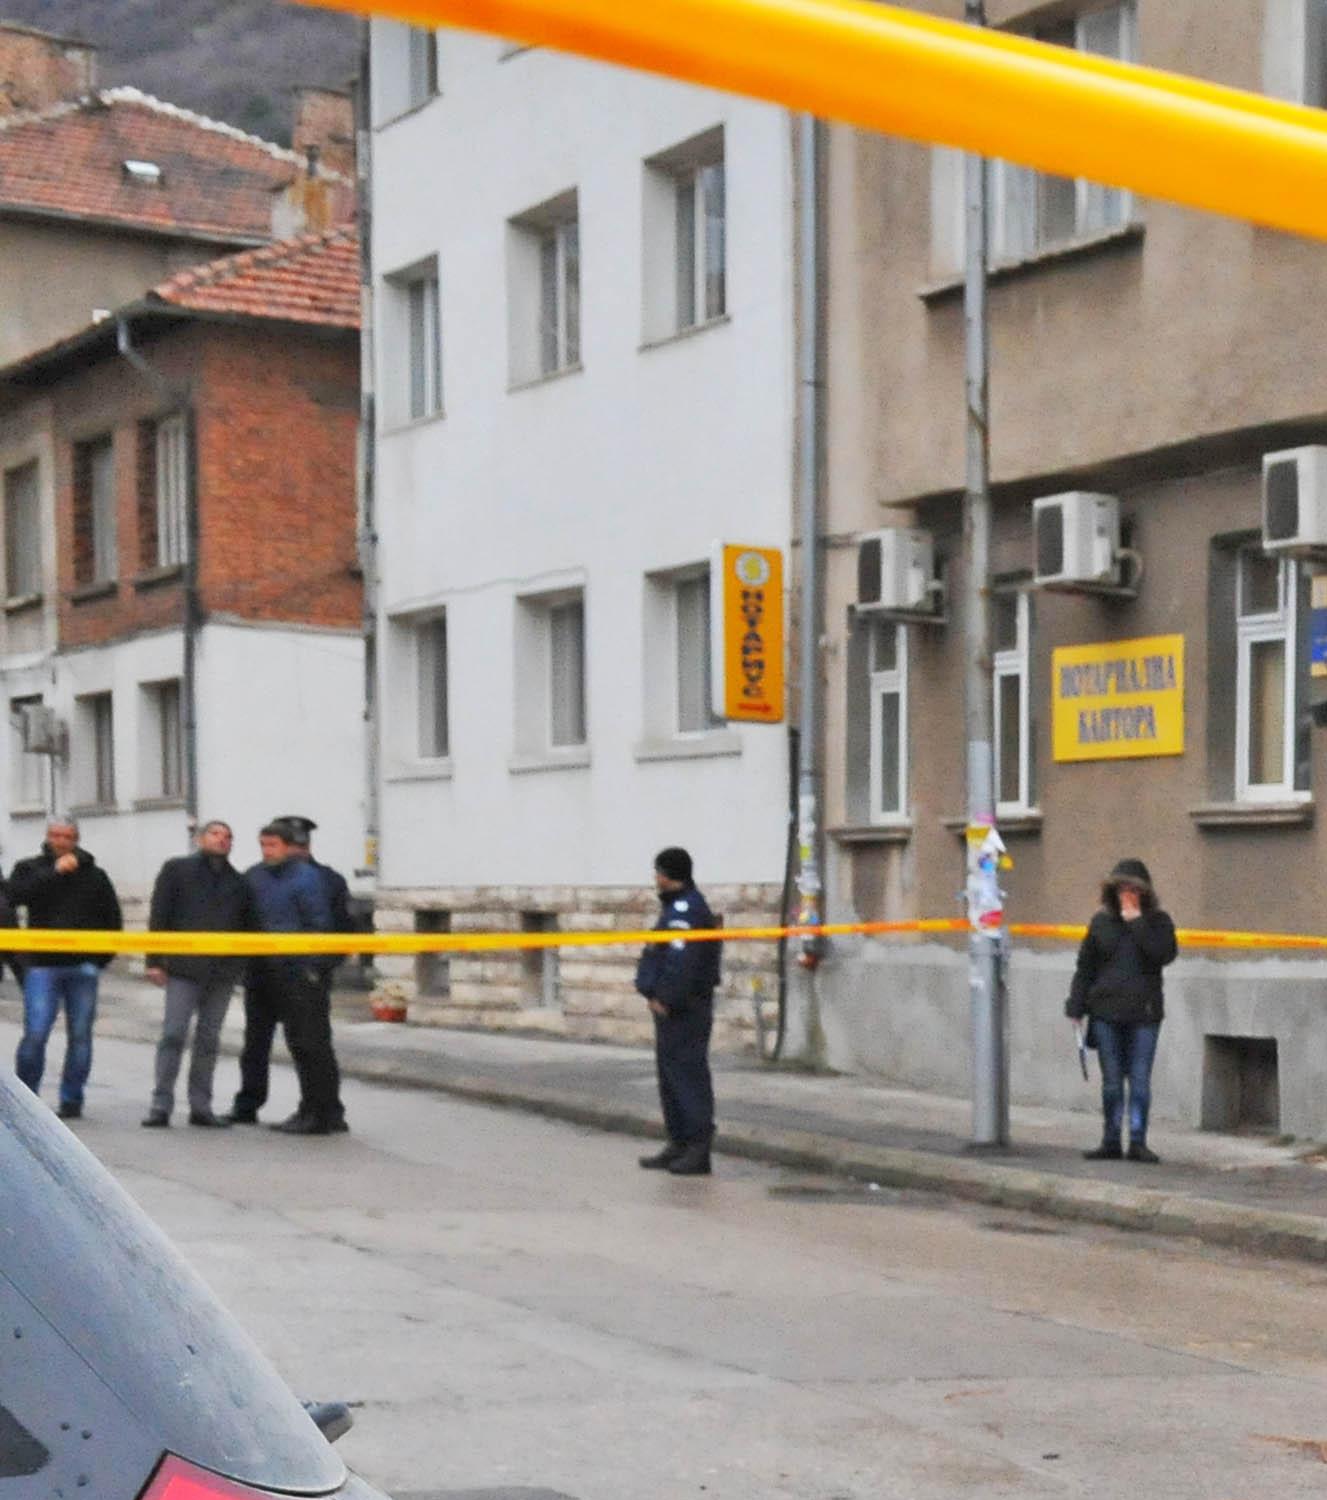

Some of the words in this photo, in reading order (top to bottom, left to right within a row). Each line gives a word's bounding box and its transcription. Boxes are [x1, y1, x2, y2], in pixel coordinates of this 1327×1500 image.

[741, 589, 765, 698] НОТАРИУС
[1060, 655, 1177, 700] НОТАРИАЛНА
[1078, 705, 1157, 744] КАНТОРА
